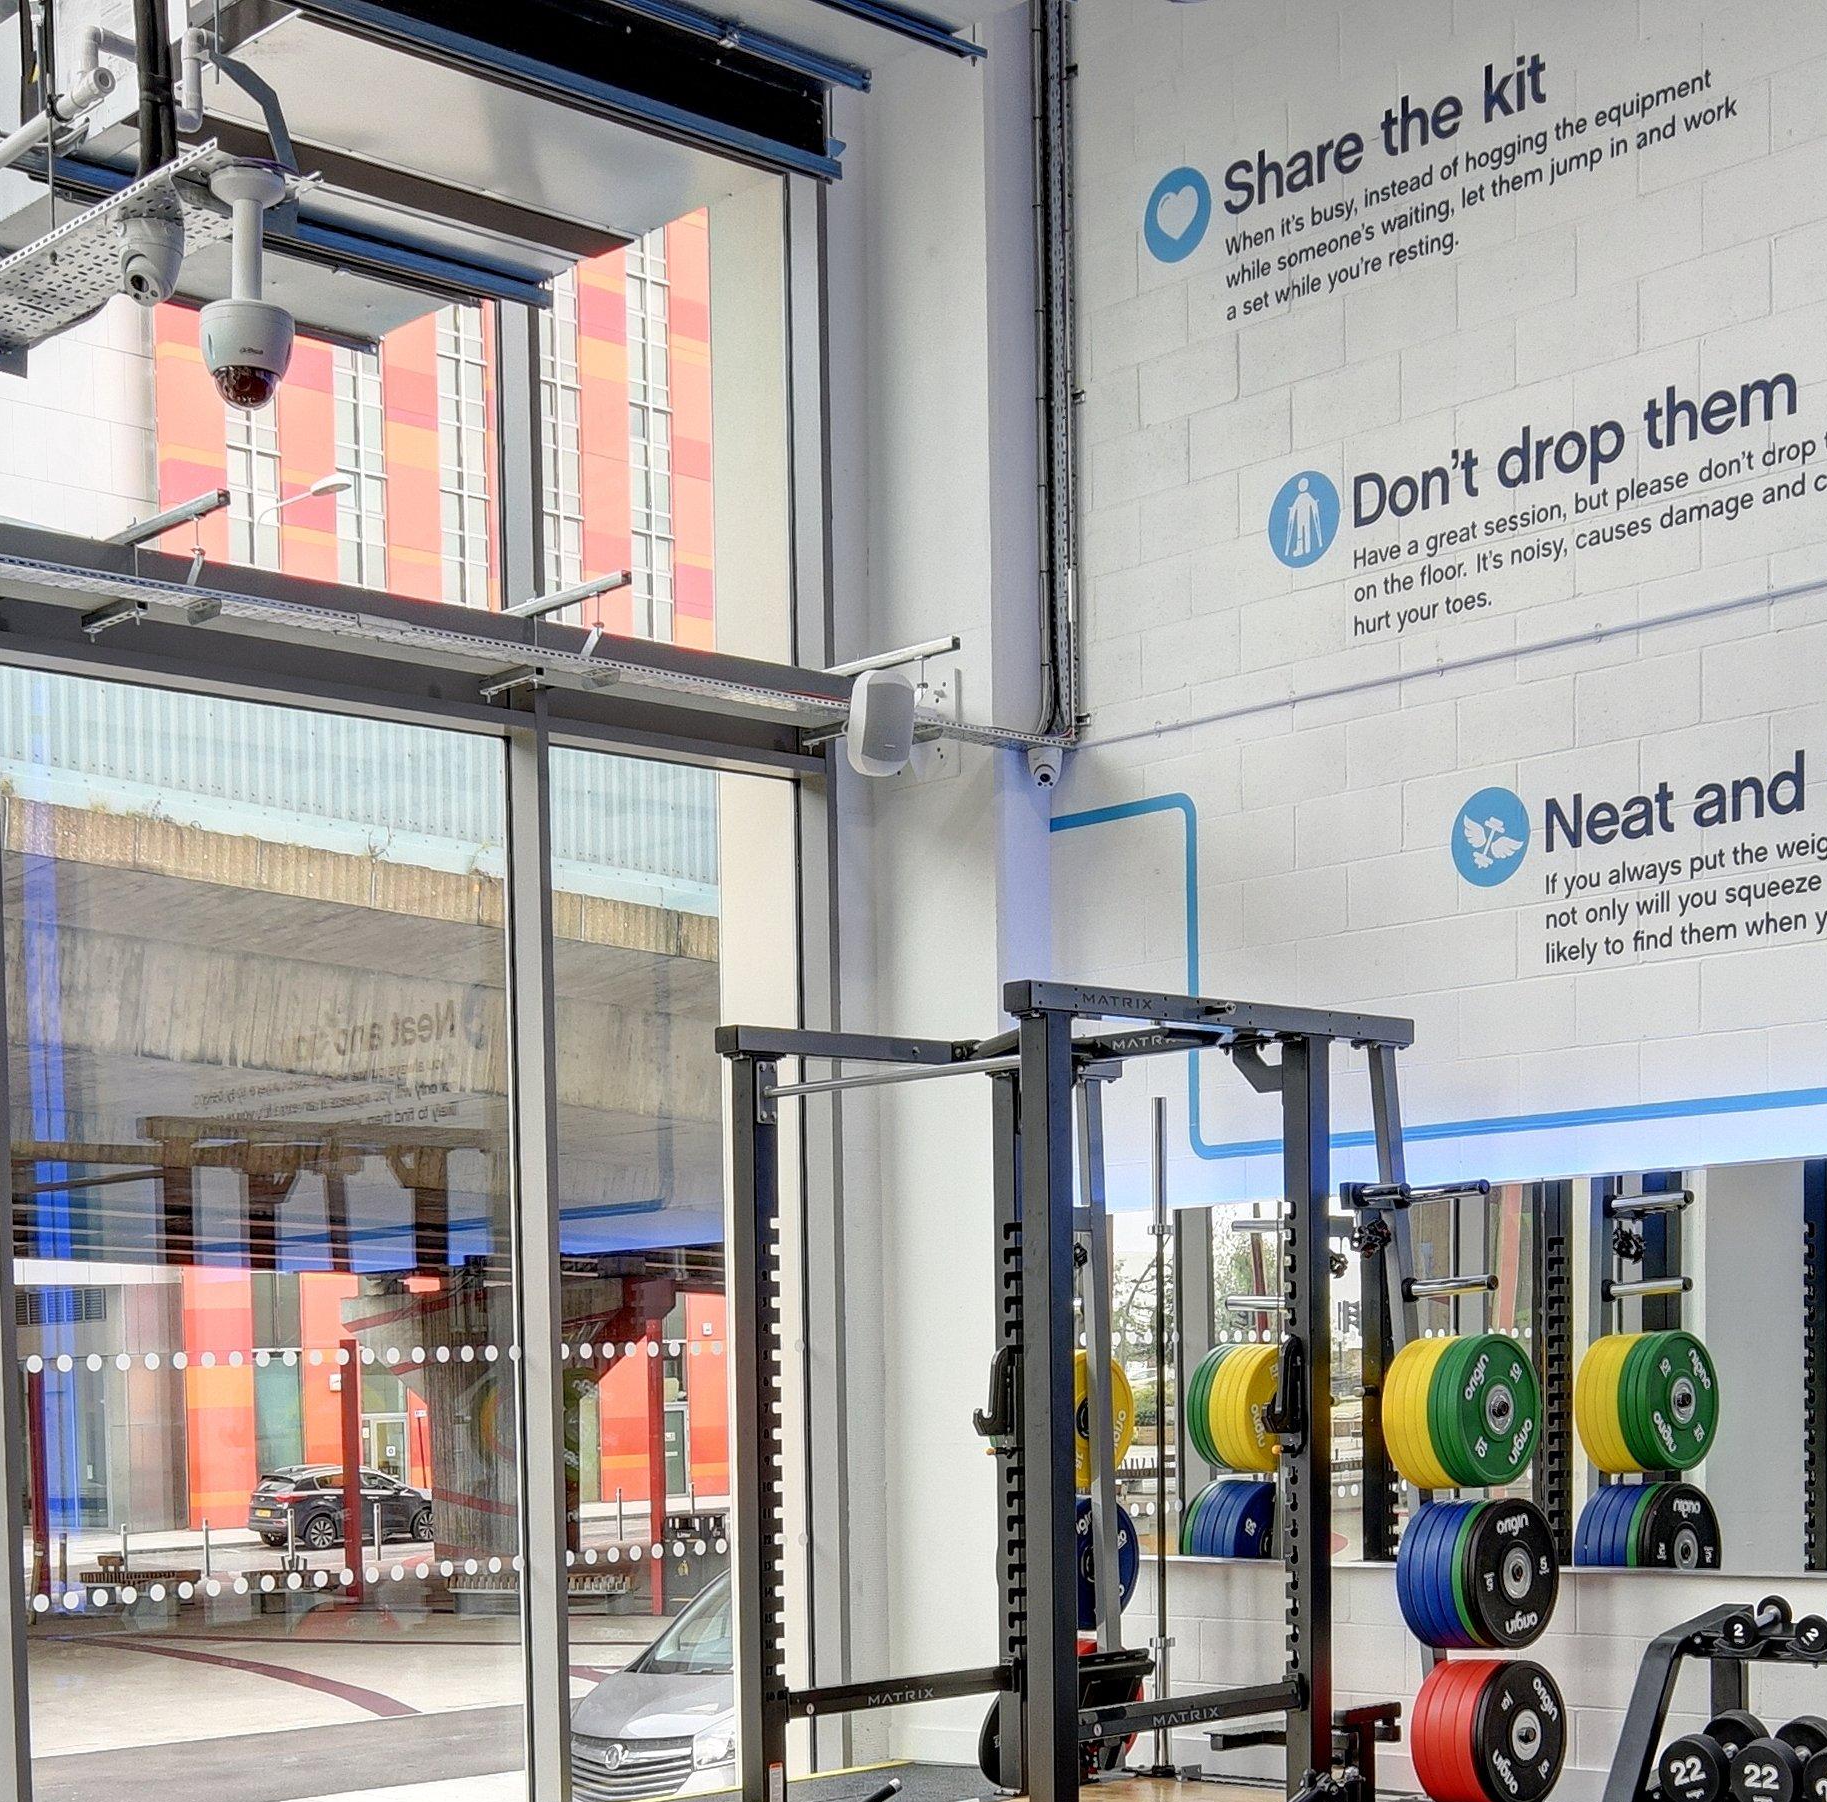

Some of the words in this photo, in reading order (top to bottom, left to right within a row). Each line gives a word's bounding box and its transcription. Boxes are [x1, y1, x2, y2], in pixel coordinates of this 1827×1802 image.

[1223, 132, 1365, 215] Share
[1380, 94, 1464, 157] the
[1483, 53, 1547, 124] kit
[1225, 227, 1275, 256] When
[1280, 214, 1305, 238] it's
[1310, 197, 1358, 227] busy,
[1364, 163, 1434, 208] instead
[1439, 155, 1459, 181] of
[1465, 130, 1548, 173] hogging
[1554, 117, 1588, 142] the
[1594, 68, 1712, 128] equipment
[1225, 258, 1272, 289] while
[1277, 222, 1375, 272] someone's
[1380, 199, 1455, 235] waiting,
[1461, 183, 1485, 209] let
[1490, 167, 1543, 198] them
[1548, 147, 1603, 186] jump
[1610, 137, 1628, 159] in
[1636, 114, 1676, 150] and
[1683, 95, 1738, 133] work
[1226, 305, 1237, 321] a
[1242, 290, 1270, 316] set
[1274, 273, 1322, 305] while
[1327, 256, 1383, 295] you're
[1388, 231, 1459, 267] resting.
[1353, 448, 1479, 529] Don't
[1497, 420, 1626, 489] drop
[1643, 372, 1797, 450] them
[1353, 544, 1402, 570] Have
[1407, 539, 1419, 556] a
[1425, 520, 1478, 558] great
[1484, 504, 1567, 537] session,
[1574, 488, 1609, 515] but
[1616, 471, 1689, 512] please
[1698, 450, 1754, 483] don't
[1761, 439, 1817, 467] drop
[1354, 583, 1377, 603] on
[1383, 572, 1414, 595] the
[1419, 561, 1467, 587] floor.
[1476, 550, 1504, 574] It's
[1510, 537, 1568, 566] noisy,
[1575, 517, 1652, 550] causes
[1659, 492, 1754, 529] damage
[1762, 471, 1806, 505] and
[1354, 610, 1391, 637] hurt
[1396, 602, 1439, 634] your
[1444, 591, 1492, 615] toes.
[1545, 781, 1675, 853] Neat
[1693, 748, 1805, 828] and
[1545, 872, 1558, 895] If
[1563, 871, 1601, 900] you
[1607, 859, 1682, 886] always
[1690, 848, 1726, 880] put
[1732, 842, 1769, 866] the
[1545, 906, 1578, 930] not
[1585, 897, 1630, 926] only
[1635, 889, 1670, 916] will
[1677, 889, 1717, 918] you
[1725, 874, 1822, 908] squeeze
[1545, 937, 1598, 966] likely
[1603, 936, 1625, 956] to
[1632, 925, 1673, 952] find
[1680, 922, 1737, 946] them
[1744, 911, 1807, 937] when
[1463, 1352, 1490, 1402] origin
[1508, 1416, 1533, 1466] origin
[1495, 1512, 1529, 1538] origin
[1504, 1610, 1539, 1635] origin
[1733, 1623, 1744, 1637] 2
[1805, 1627, 1819, 1642] 2
[1151, 1706, 1221, 1727] MATRIX
[1532, 1675, 1560, 1723] origin
[1491, 1748, 1520, 1796] origin
[1670, 1756, 1707, 1787] 22
[1743, 1764, 1780, 1790] 22
